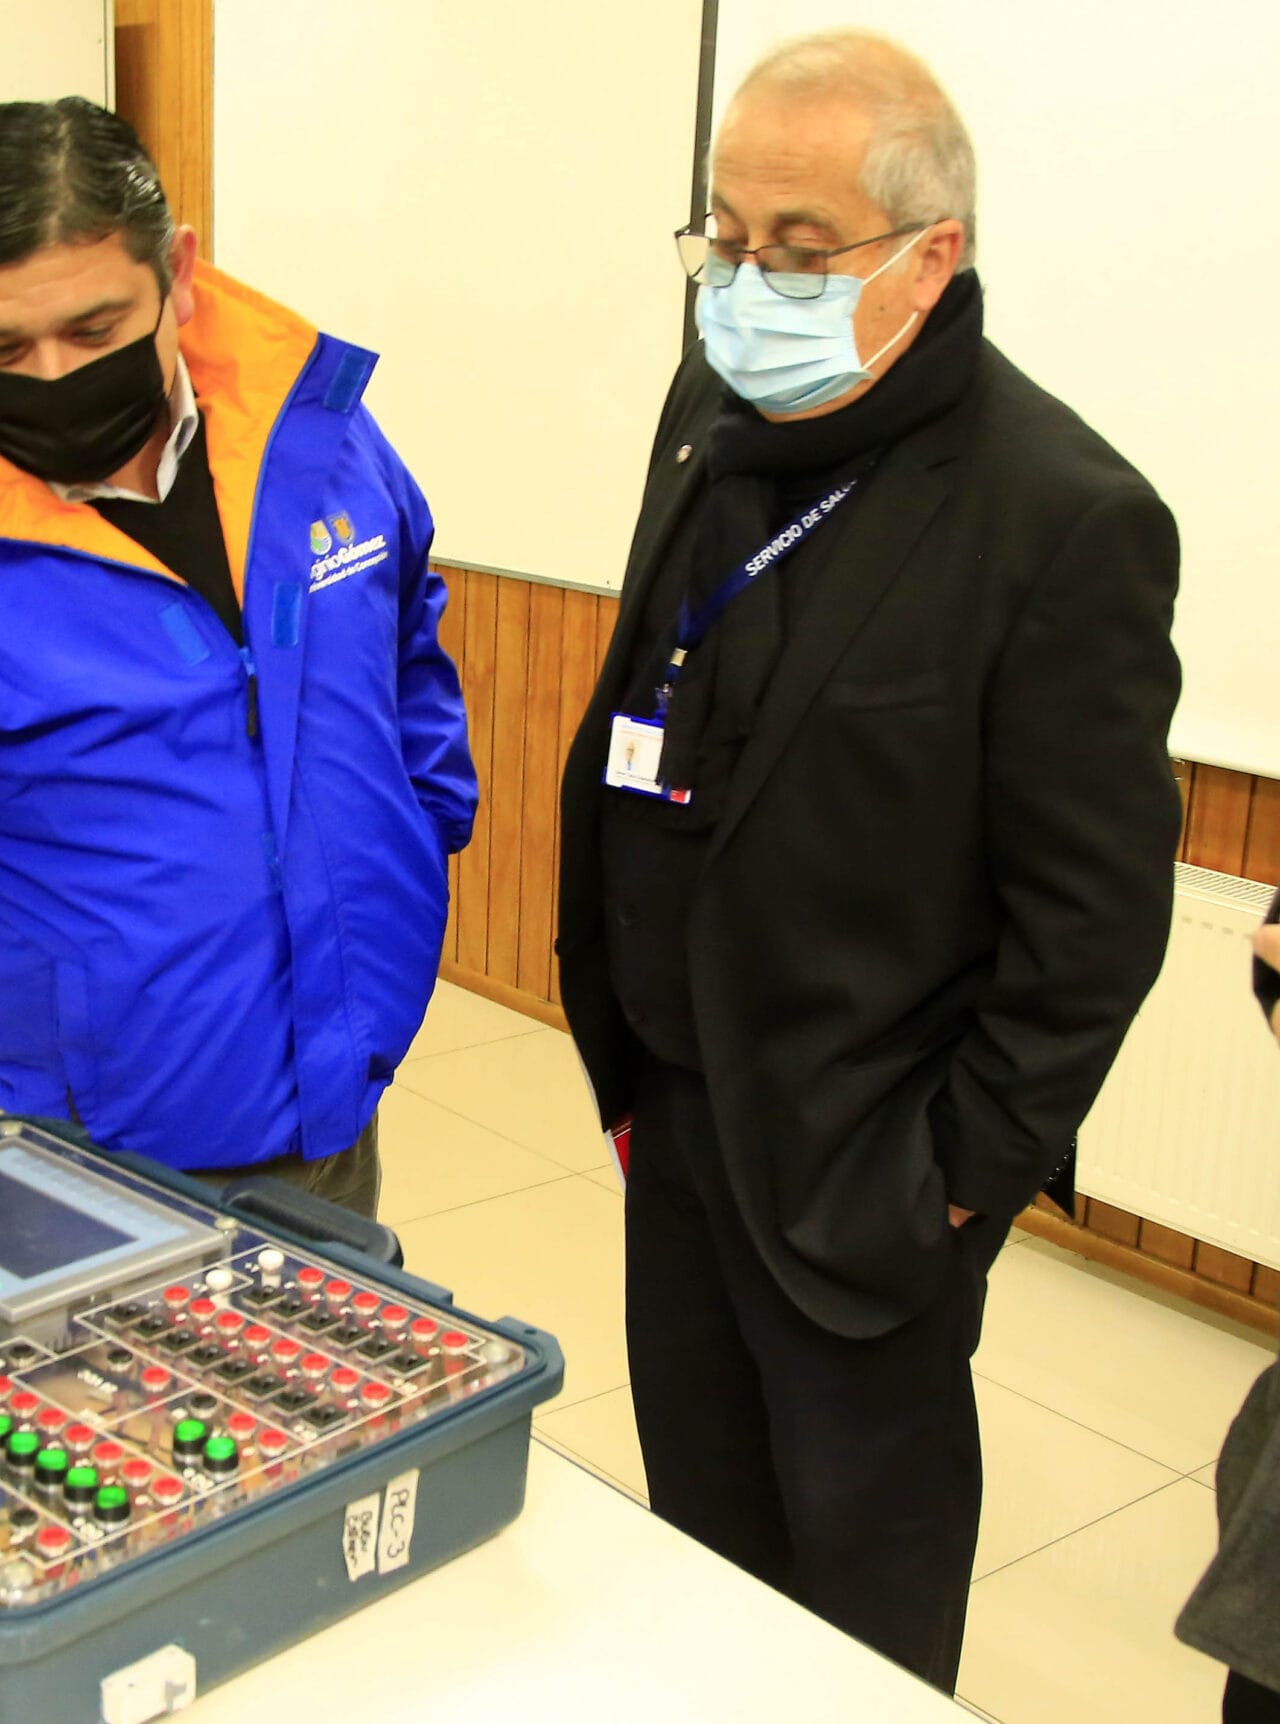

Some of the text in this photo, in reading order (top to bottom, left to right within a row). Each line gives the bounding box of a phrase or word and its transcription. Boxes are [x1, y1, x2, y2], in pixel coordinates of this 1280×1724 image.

[744, 479, 857, 577] SERVICIO DE SAL
